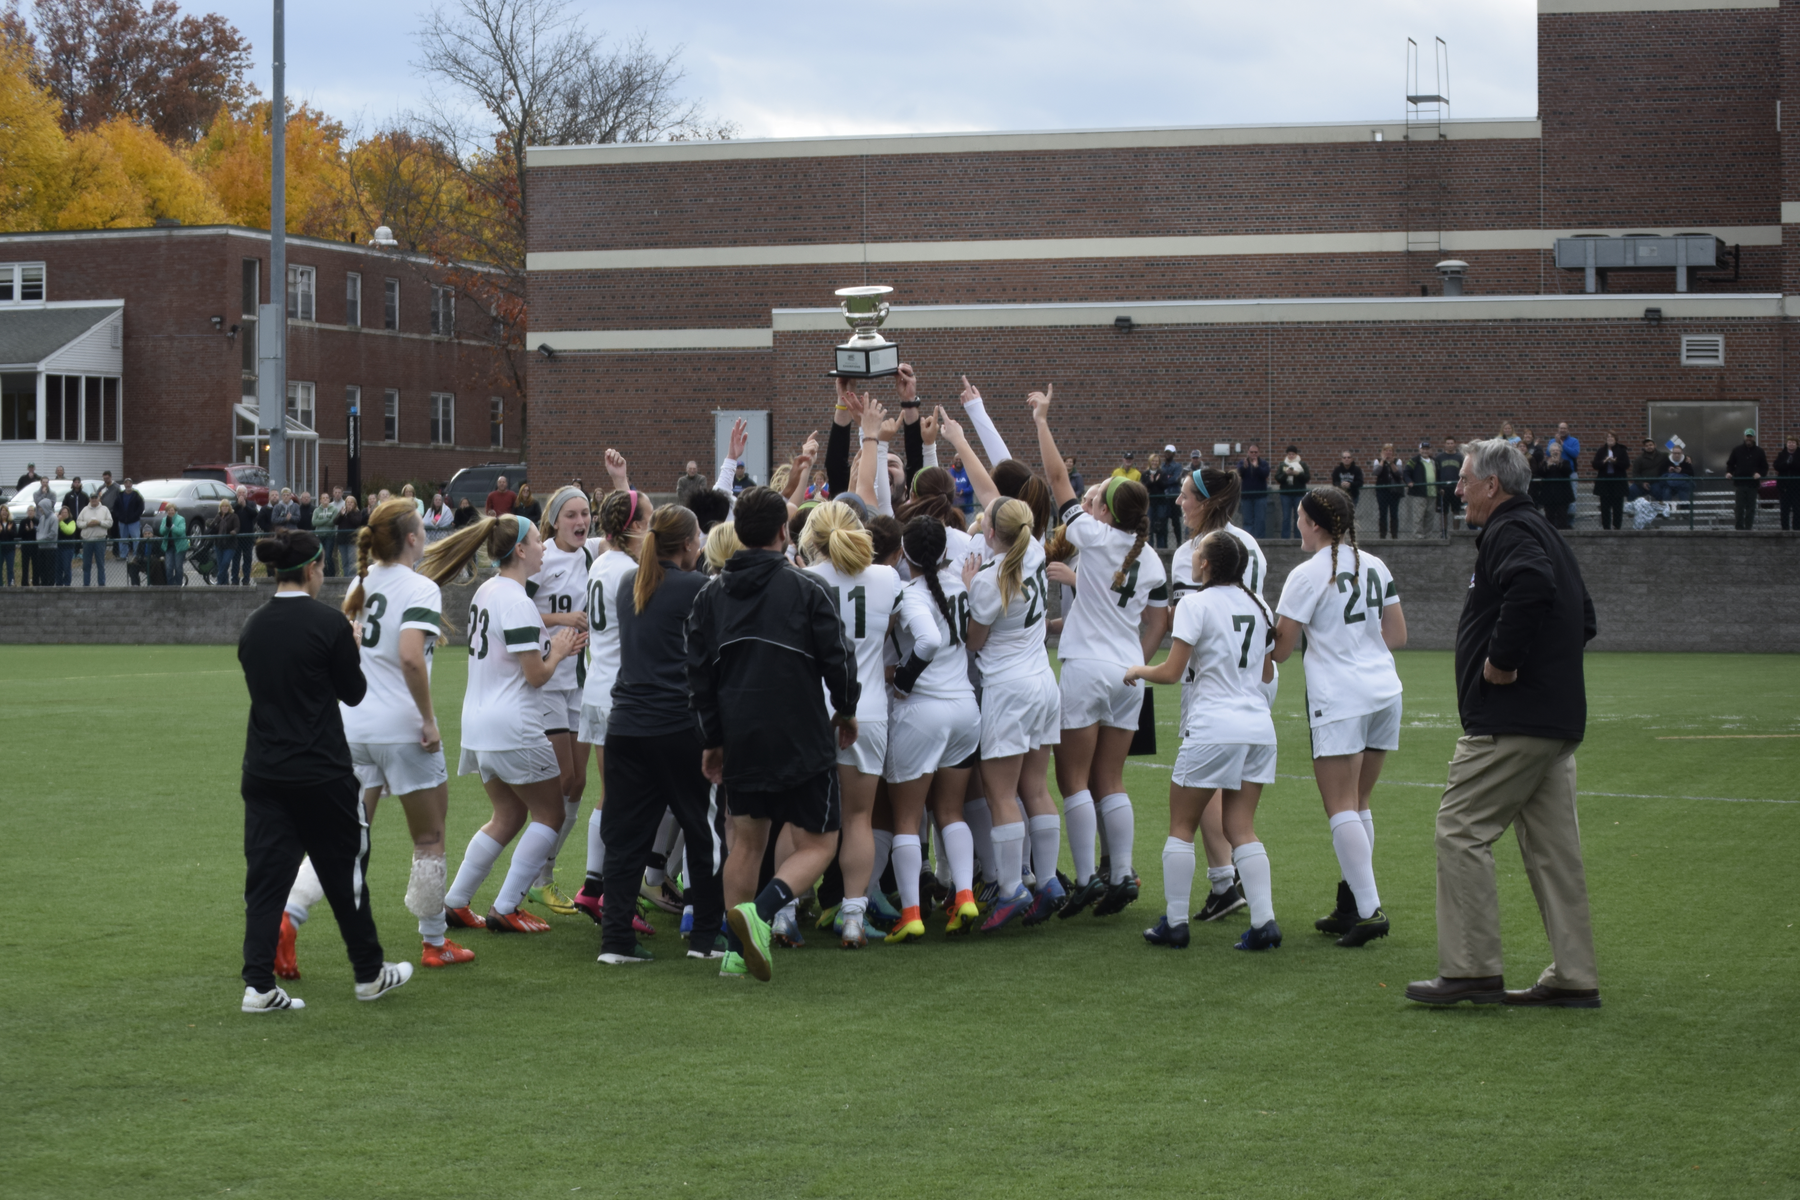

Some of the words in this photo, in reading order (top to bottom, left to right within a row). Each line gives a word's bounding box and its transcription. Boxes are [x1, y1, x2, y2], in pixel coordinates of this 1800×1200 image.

[548, 594, 572, 614] 19
[1110, 560, 1141, 608] 4
[1336, 568, 1384, 625] 24
[468, 603, 490, 660] 23
[1231, 615, 1256, 668] 7
